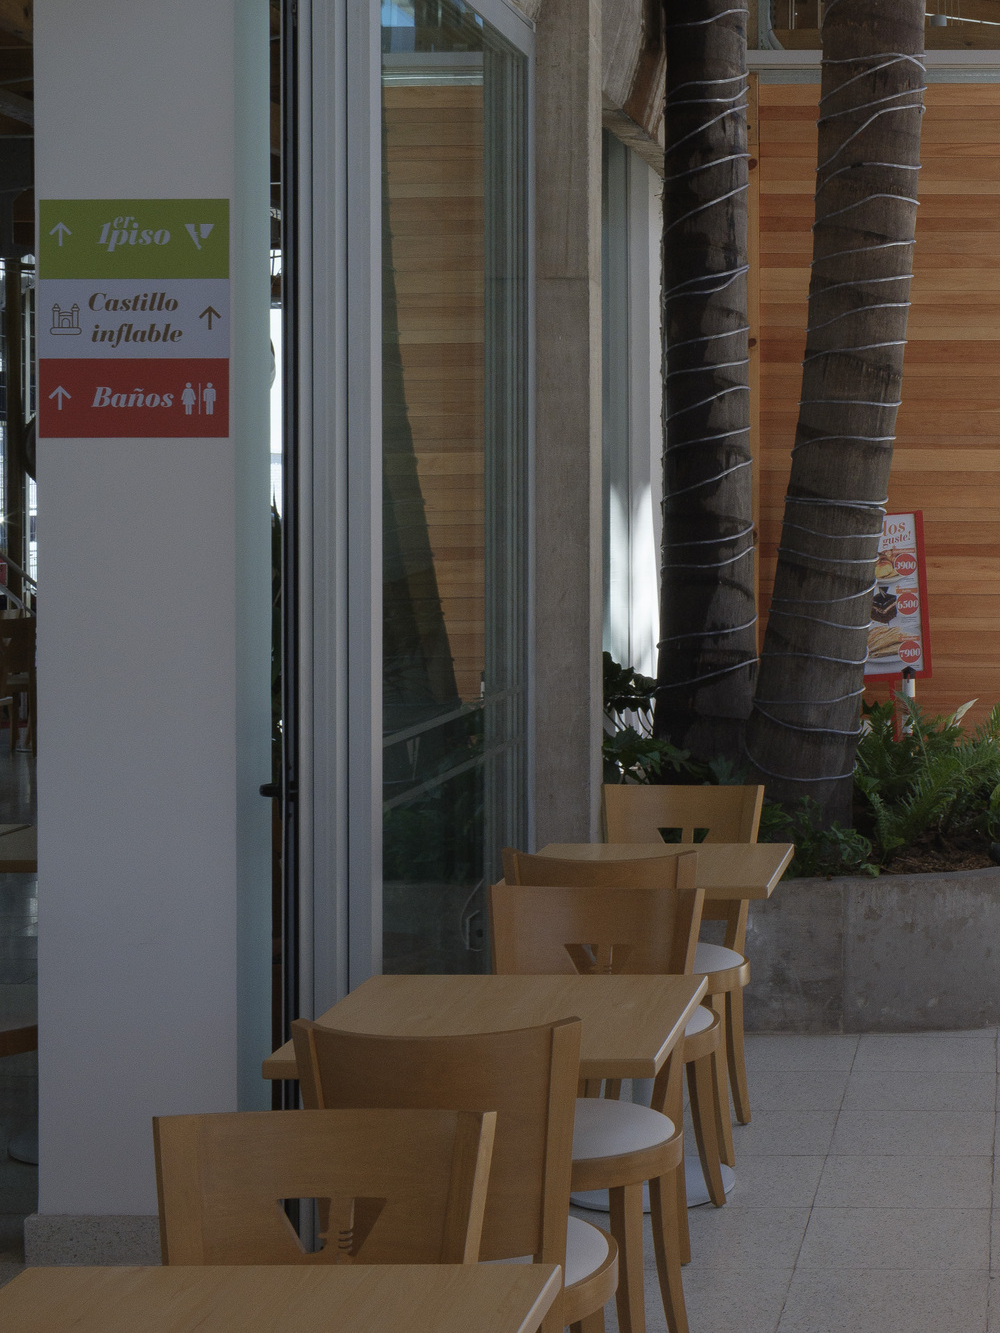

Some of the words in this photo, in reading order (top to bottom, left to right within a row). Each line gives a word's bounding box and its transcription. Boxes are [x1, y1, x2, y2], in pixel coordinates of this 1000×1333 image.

[106, 222, 171, 252] piso
[88, 292, 179, 312] Castillo
[91, 323, 183, 348] inflable
[91, 386, 175, 408] Baños
[897, 598, 919, 610] 6500
[899, 647, 921, 659] 7900
